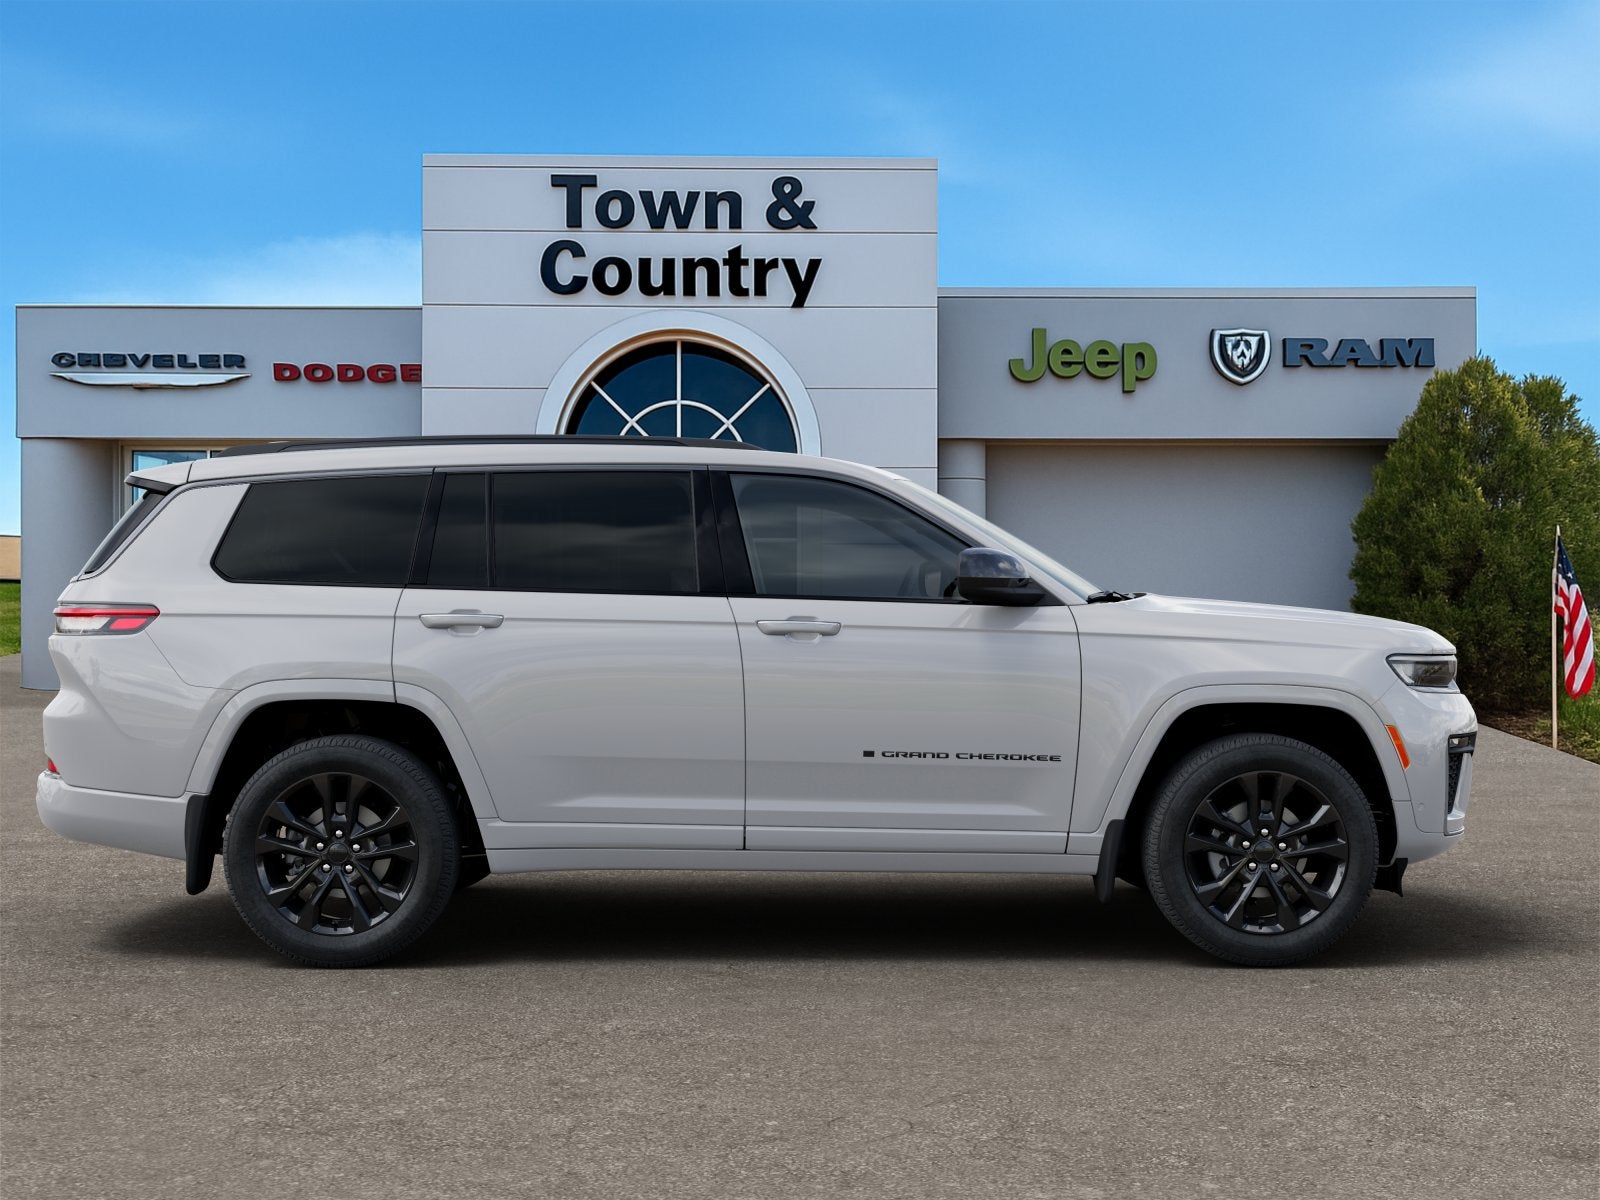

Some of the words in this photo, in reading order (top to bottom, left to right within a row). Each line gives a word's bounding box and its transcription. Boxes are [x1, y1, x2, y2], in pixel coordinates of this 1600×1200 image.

[551, 174, 742, 229] Town
[765, 175, 818, 230] &
[540, 239, 822, 308] Country
[273, 363, 422, 383] DODGE
[1009, 327, 1157, 393] Jeep
[1283, 338, 1435, 367] RAM
[881, 750, 949, 759] GRAND
[955, 752, 1062, 762] CHEROKEE
